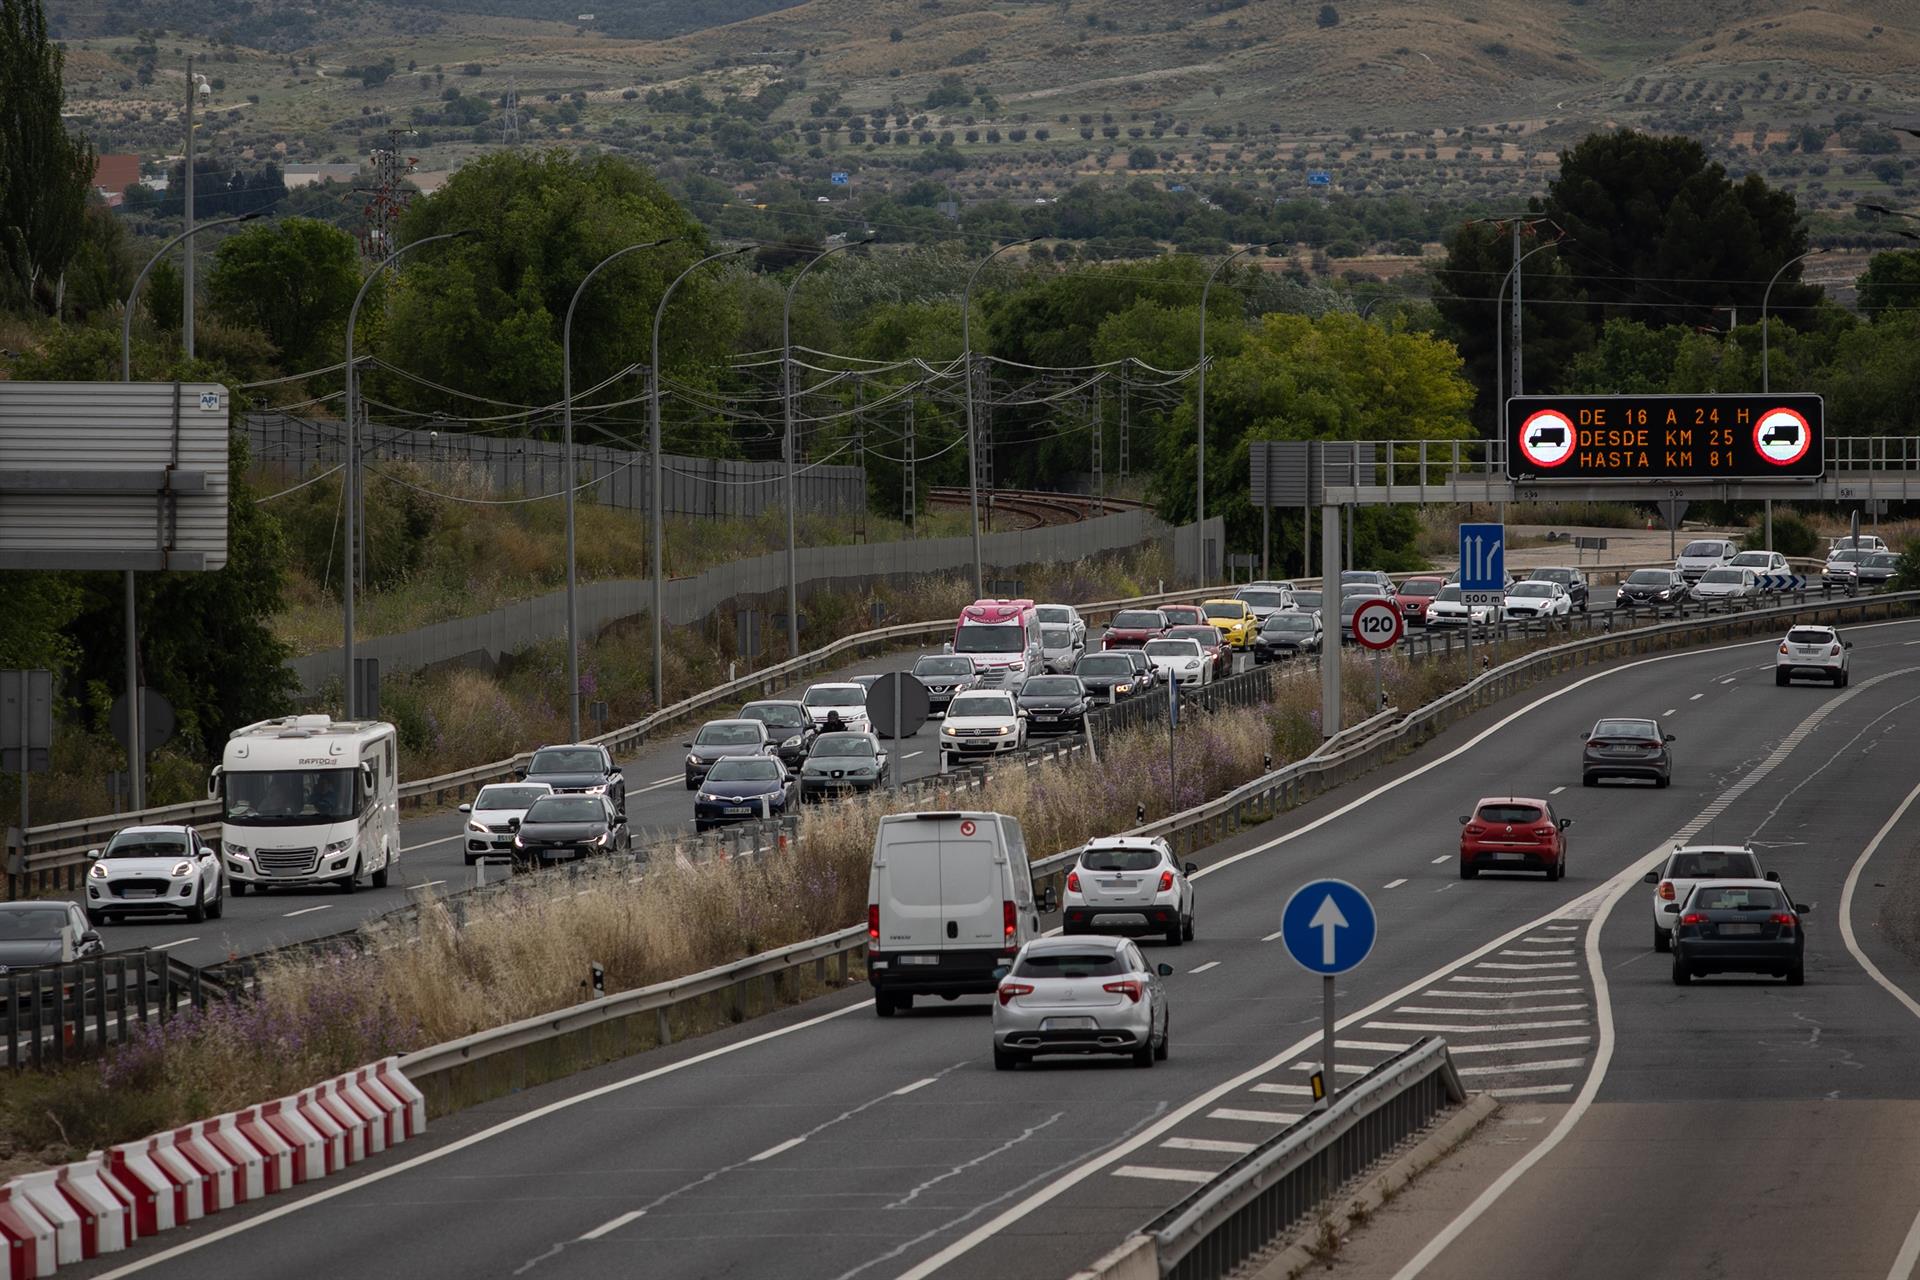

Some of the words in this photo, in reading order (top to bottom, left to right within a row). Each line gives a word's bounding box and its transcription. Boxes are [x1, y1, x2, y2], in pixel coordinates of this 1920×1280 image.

[201, 396, 218, 404] API
[1580, 408, 1606, 425] DE
[1626, 408, 1648, 425] 16
[1666, 408, 1677, 425] A
[1695, 408, 1720, 425] 24
[1737, 408, 1749, 425] H
[1580, 430, 1649, 447] DESDE
[1666, 430, 1692, 447] KM
[1710, 430, 1734, 446] 25
[1580, 452, 1649, 468] HASTA
[1666, 452, 1692, 467] KM
[1710, 452, 1733, 467] 81
[1465, 594, 1488, 603] 500
[1361, 616, 1393, 633] 120
